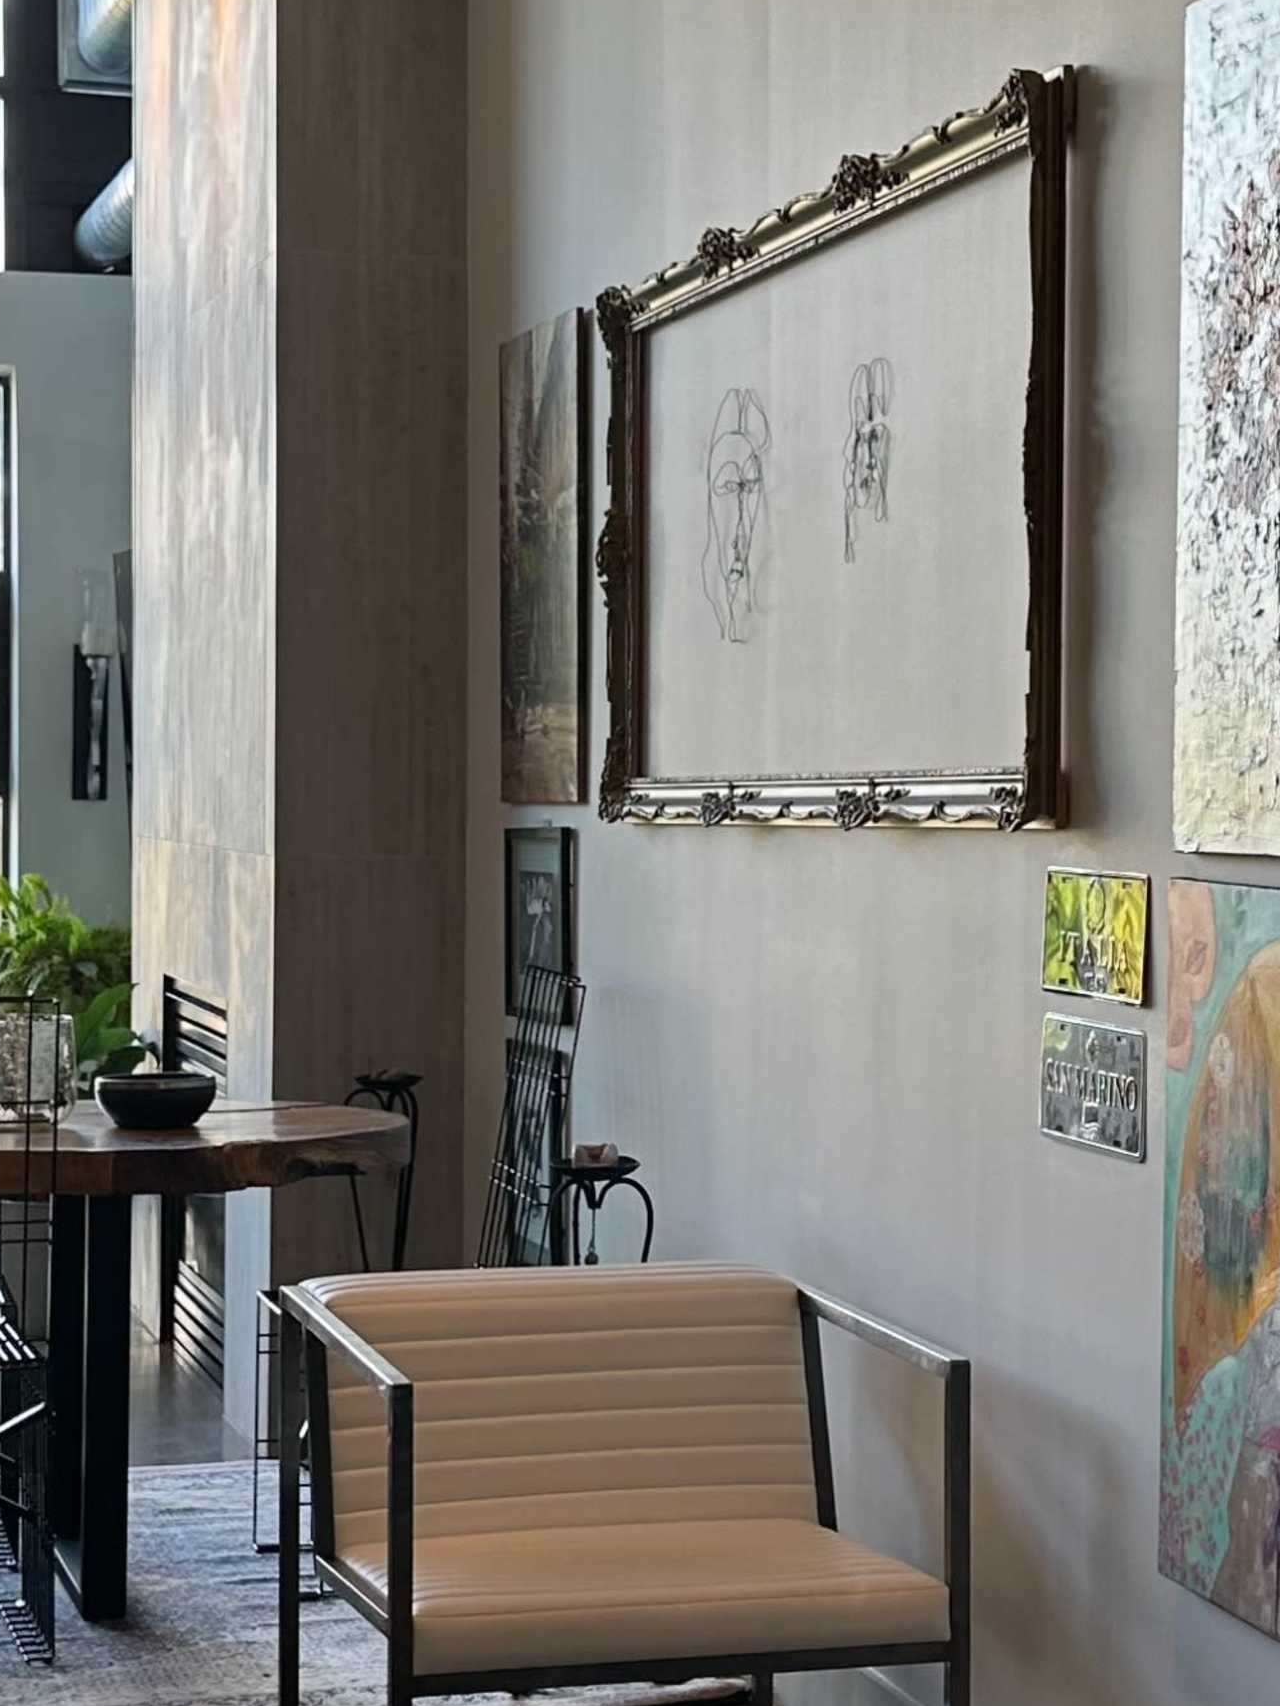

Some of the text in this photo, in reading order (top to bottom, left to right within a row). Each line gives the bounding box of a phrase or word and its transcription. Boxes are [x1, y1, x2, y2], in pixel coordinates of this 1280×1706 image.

[1060, 930, 1129, 973] ITALIA
[1045, 1057, 1138, 1113] SAN MARINO
